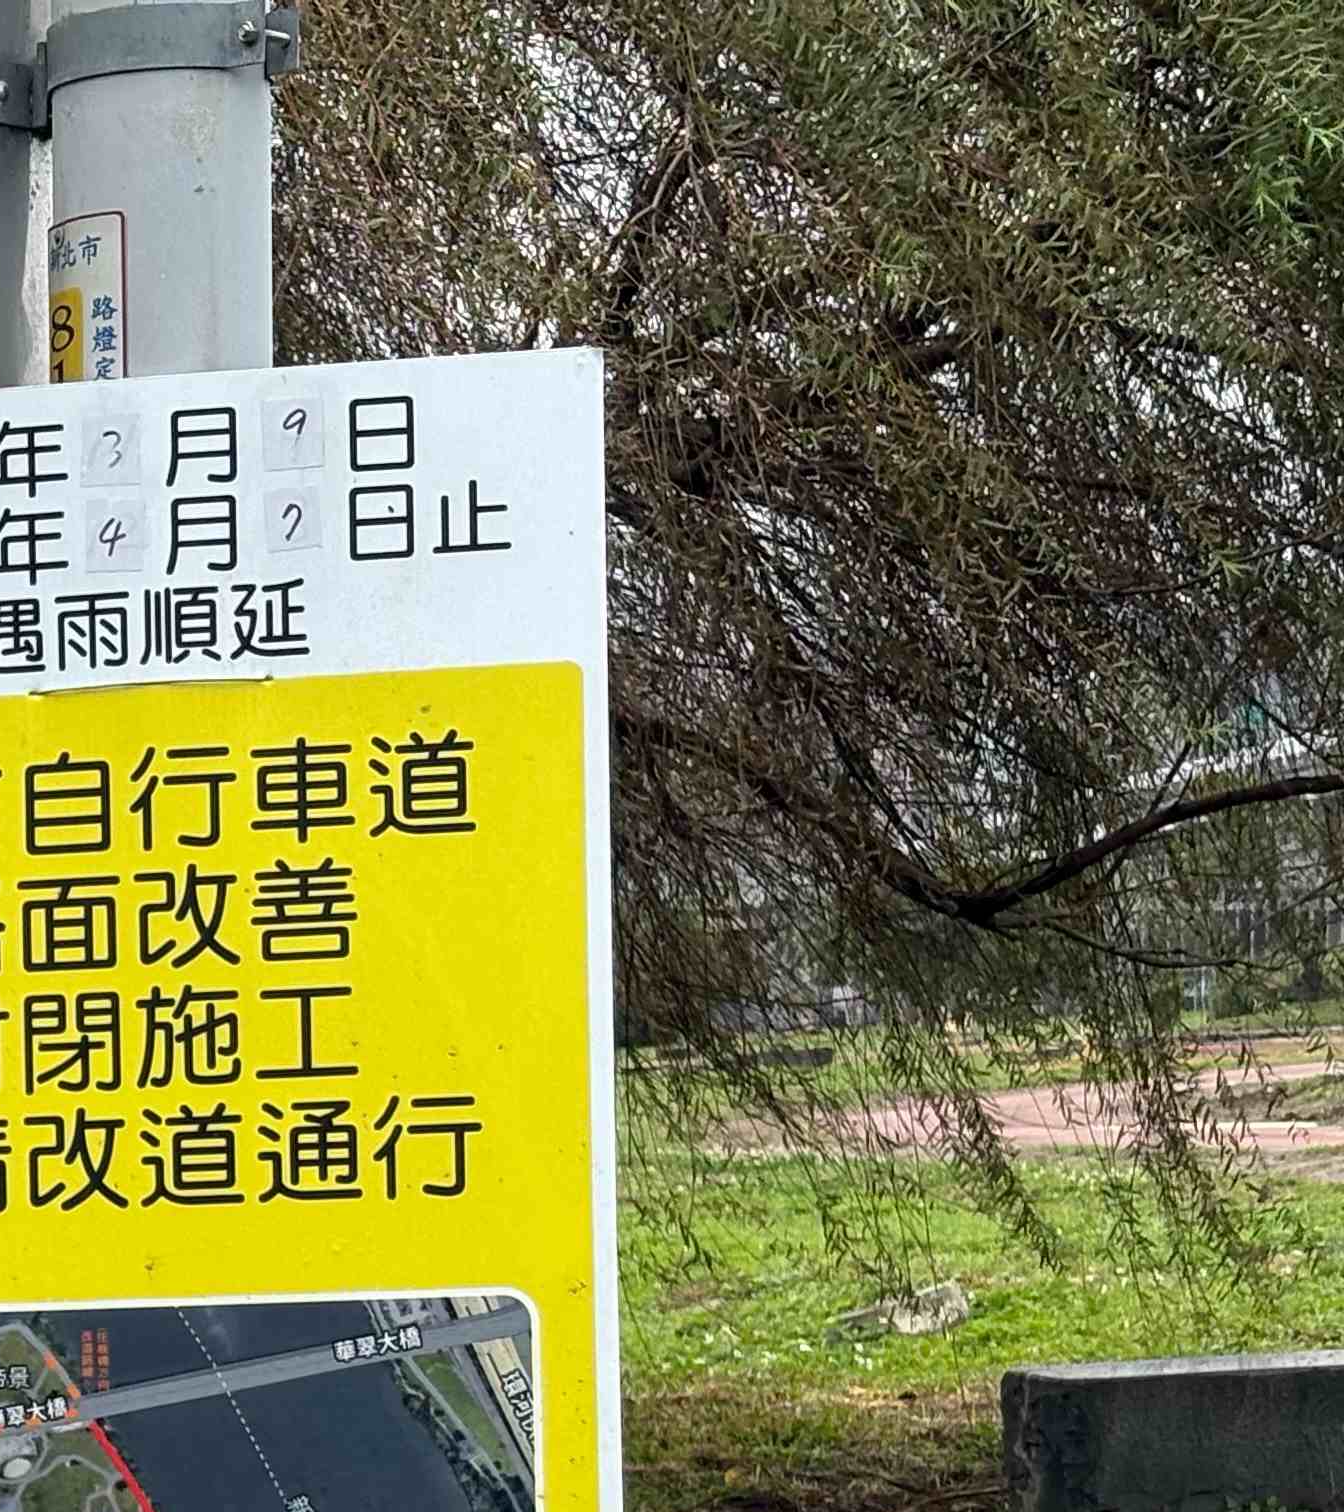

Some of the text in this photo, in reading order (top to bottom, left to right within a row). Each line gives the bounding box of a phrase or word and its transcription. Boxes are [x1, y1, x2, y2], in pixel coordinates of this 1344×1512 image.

[92, 295, 118, 381] 路燈定
[333, 1327, 423, 1361] 華翠大橋
